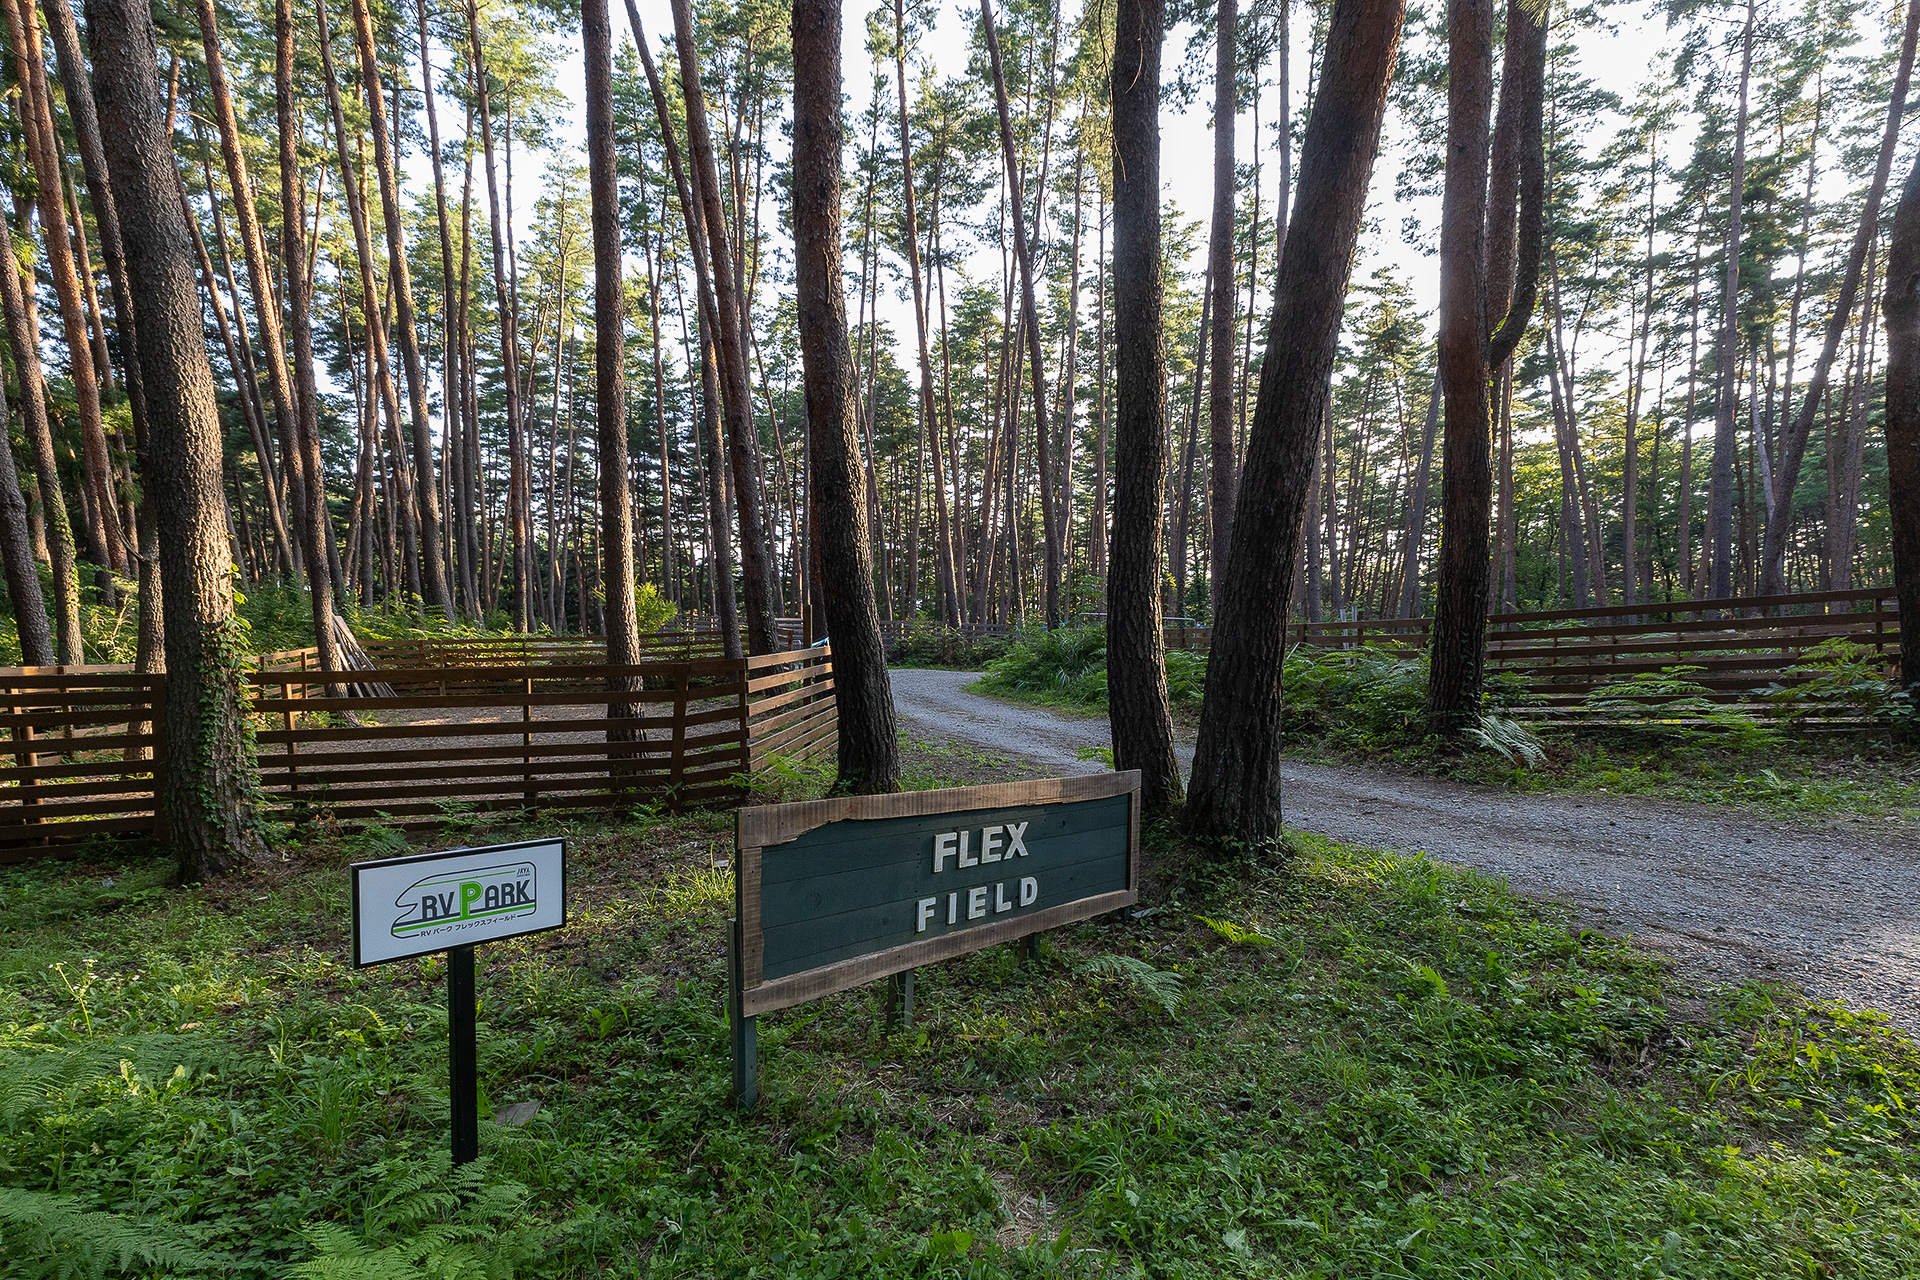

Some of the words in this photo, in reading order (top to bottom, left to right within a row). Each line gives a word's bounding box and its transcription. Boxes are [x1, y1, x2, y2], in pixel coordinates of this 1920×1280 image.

[932, 821, 1029, 873] FLEX
[421, 891, 455, 920] RV
[459, 880, 531, 918] PARK
[915, 876, 1039, 933] FIELD
